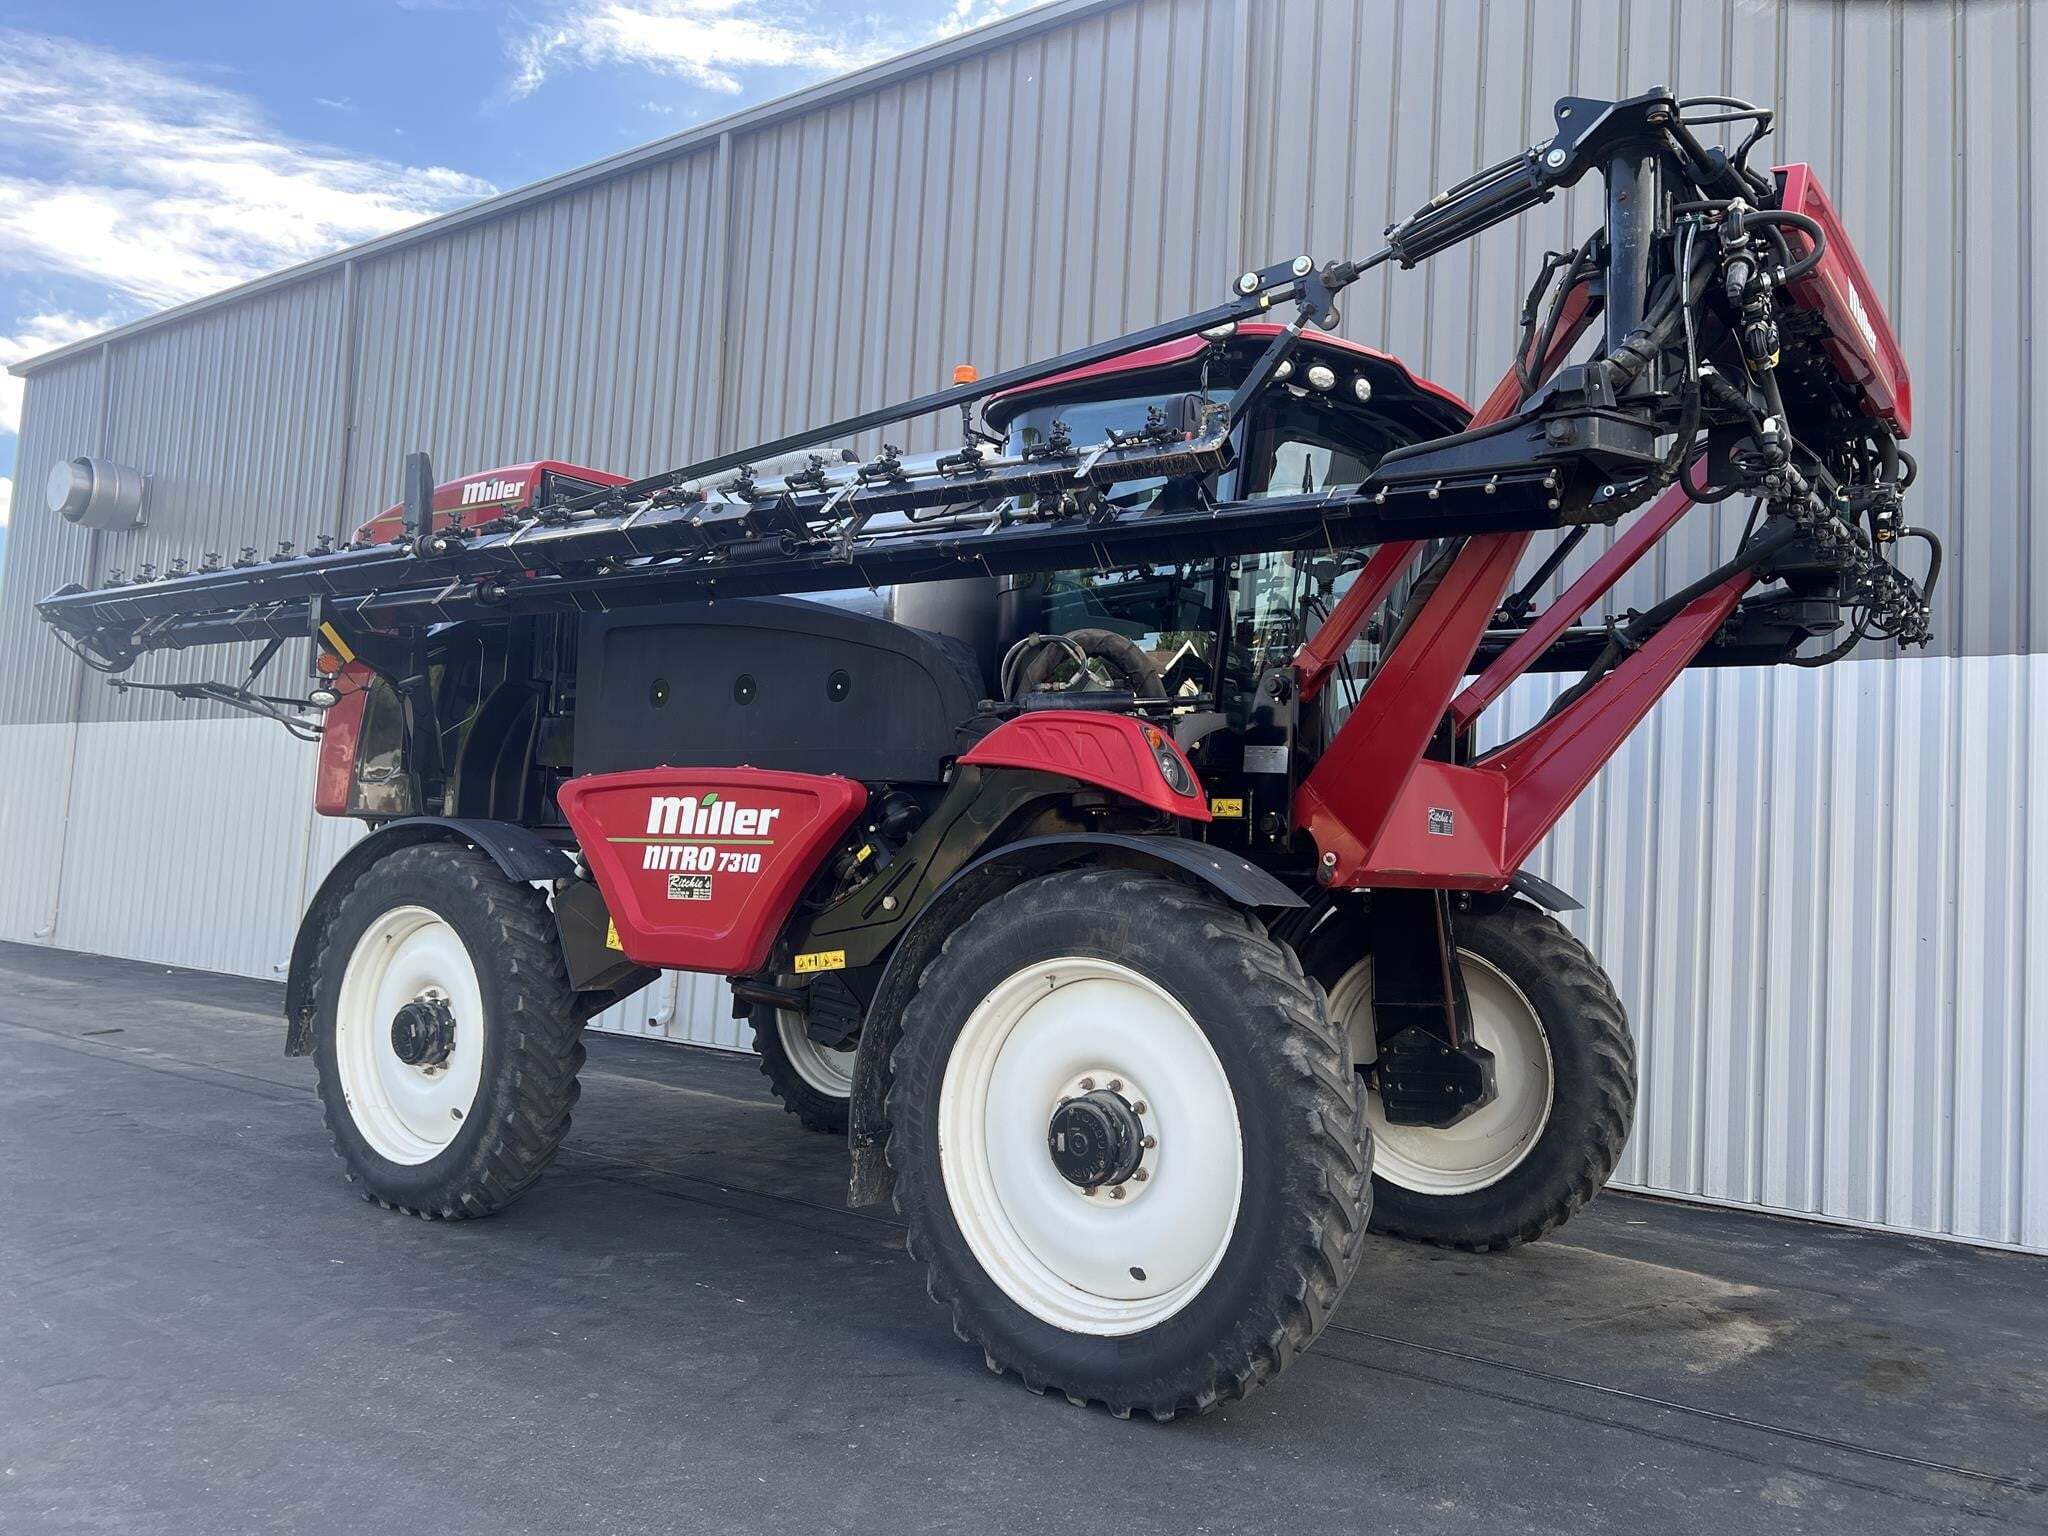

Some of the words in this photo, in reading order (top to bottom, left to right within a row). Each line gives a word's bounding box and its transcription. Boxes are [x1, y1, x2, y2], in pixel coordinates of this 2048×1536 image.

[642, 845, 716, 872] NITRO
[717, 852, 761, 873] 7310
[670, 875, 710, 888] Ritchie's
